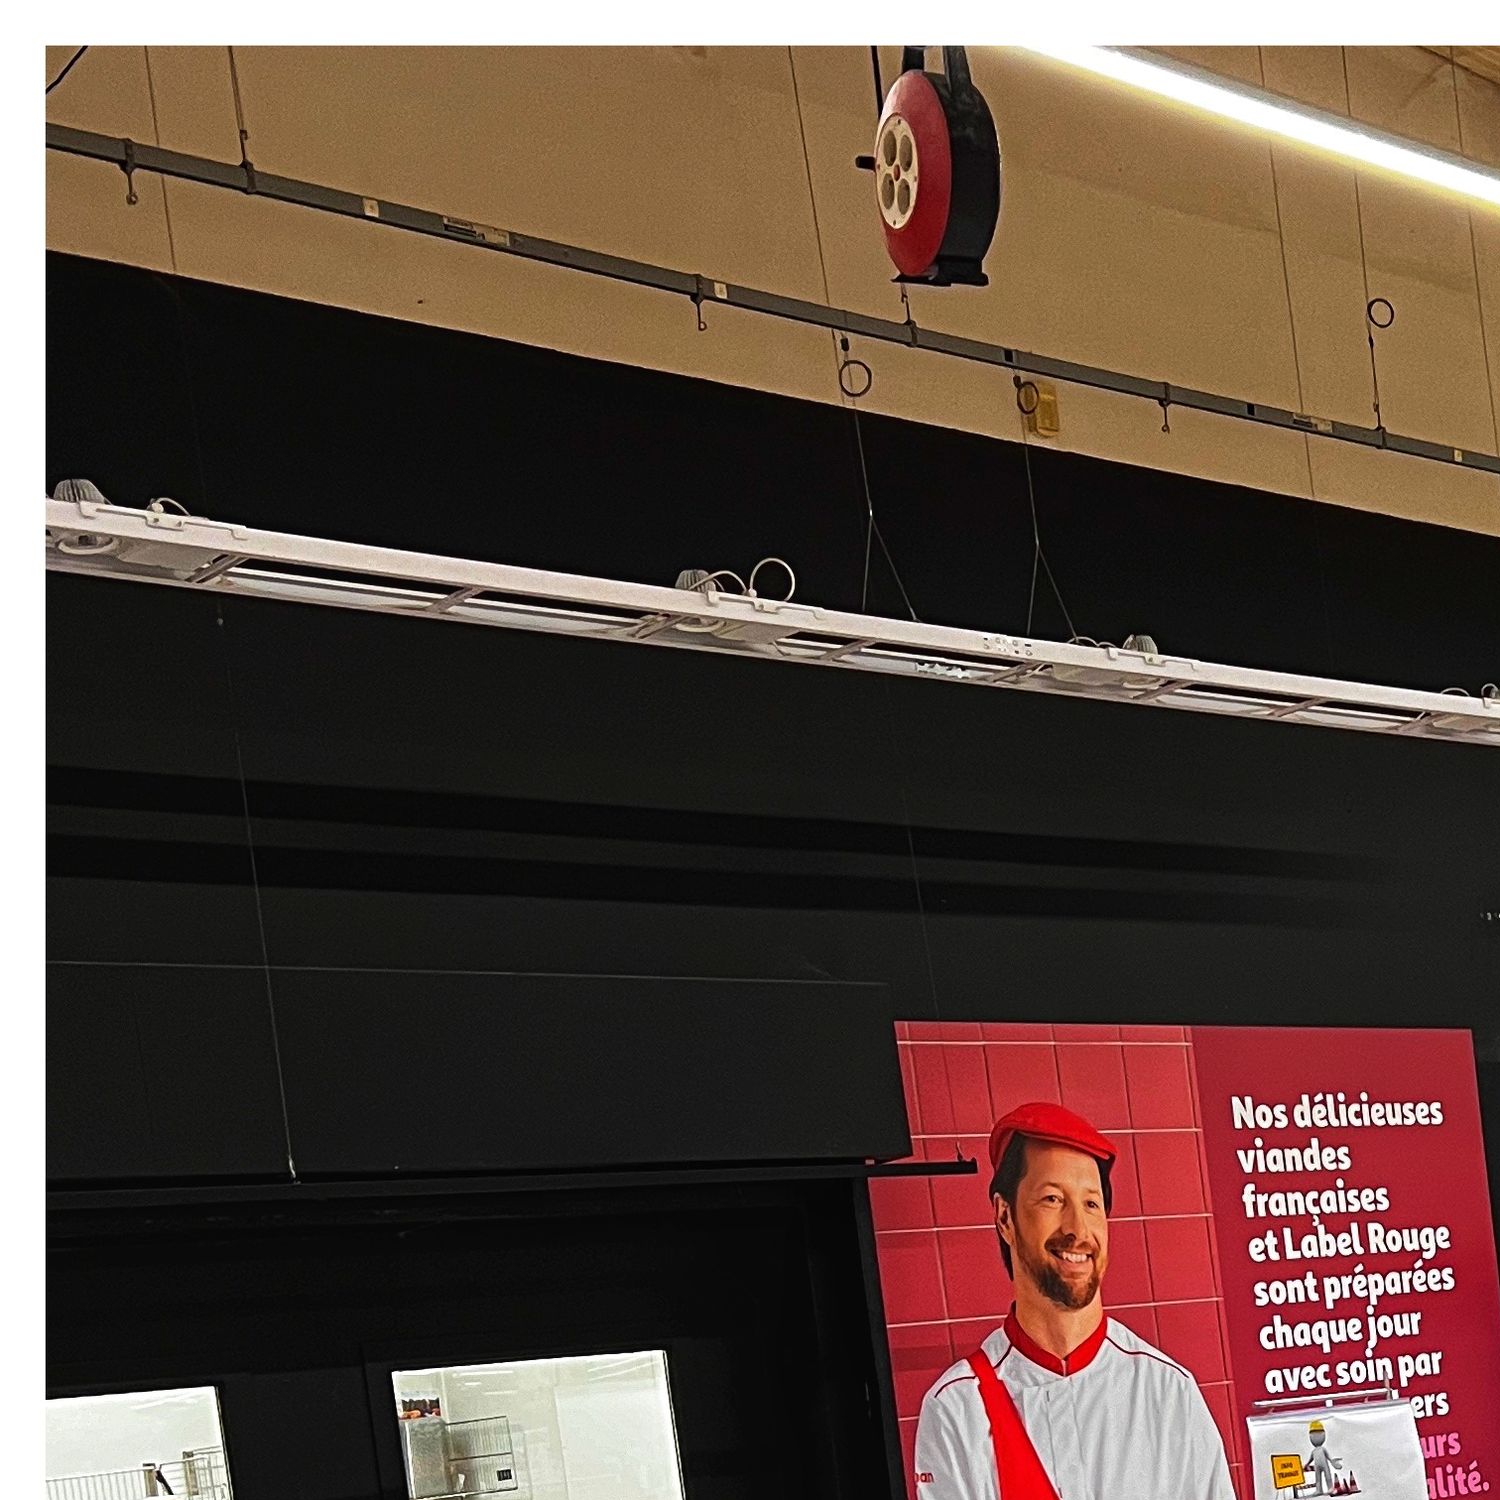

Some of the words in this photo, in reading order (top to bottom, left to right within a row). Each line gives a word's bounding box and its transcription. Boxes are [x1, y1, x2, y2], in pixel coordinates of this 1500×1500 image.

[1231, 1096, 1288, 1129] Nos
[1293, 1091, 1443, 1128] délicieuses
[1237, 1137, 1351, 1173] viandes
[1242, 1178, 1390, 1227] françaises
[1249, 1230, 1280, 1262] et
[1283, 1222, 1364, 1260] Label
[1367, 1222, 1451, 1260] Rouge
[1254, 1271, 1320, 1307] sont
[1323, 1258, 1455, 1309] préparées
[1259, 1315, 1363, 1354] chaque
[1366, 1304, 1422, 1349] jour
[1265, 1363, 1332, 1394] avec
[1336, 1347, 1393, 1387] soin
[1397, 1351, 1442, 1387] par
[1410, 1392, 1450, 1419] ers
[1420, 1432, 1461, 1459] urs
